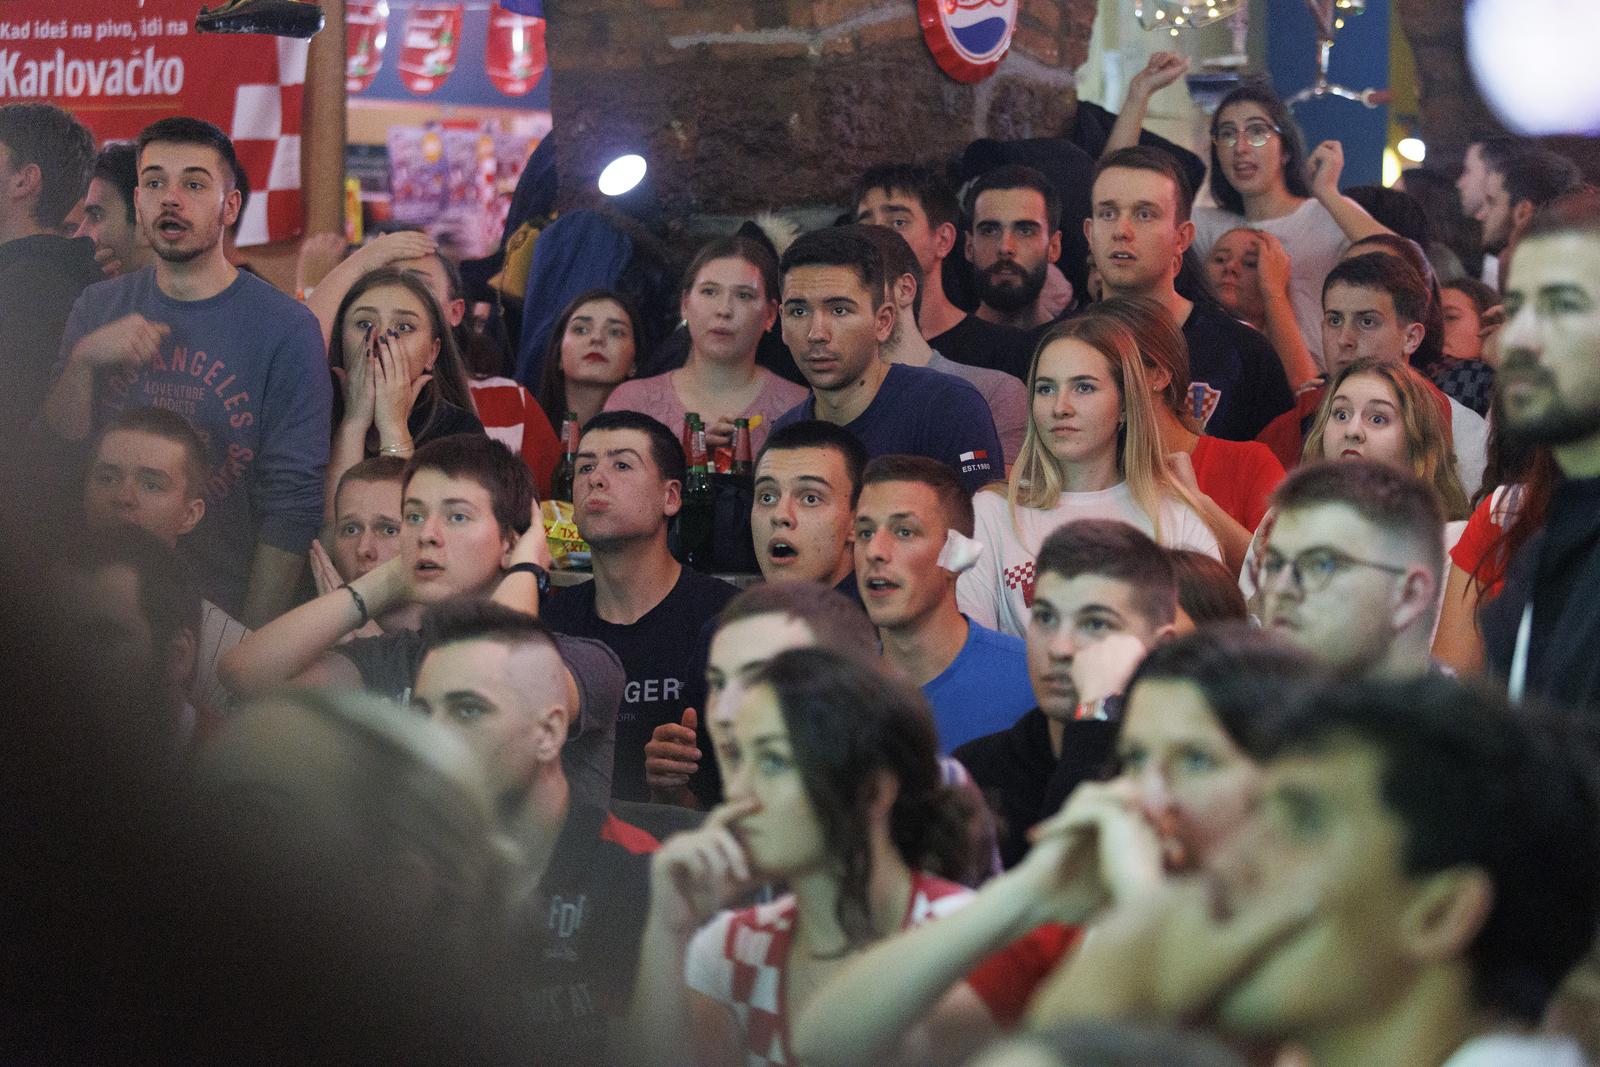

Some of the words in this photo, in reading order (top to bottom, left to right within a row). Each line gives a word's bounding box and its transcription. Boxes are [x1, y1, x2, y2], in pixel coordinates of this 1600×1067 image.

[0, 21, 31, 40] Kad
[34, 19, 68, 39] ideš
[72, 24, 92, 39] na
[96, 19, 137, 42] pivo,
[140, 16, 163, 37] idi
[166, 20, 188, 36] na
[0, 46, 185, 97] Karlovačko
